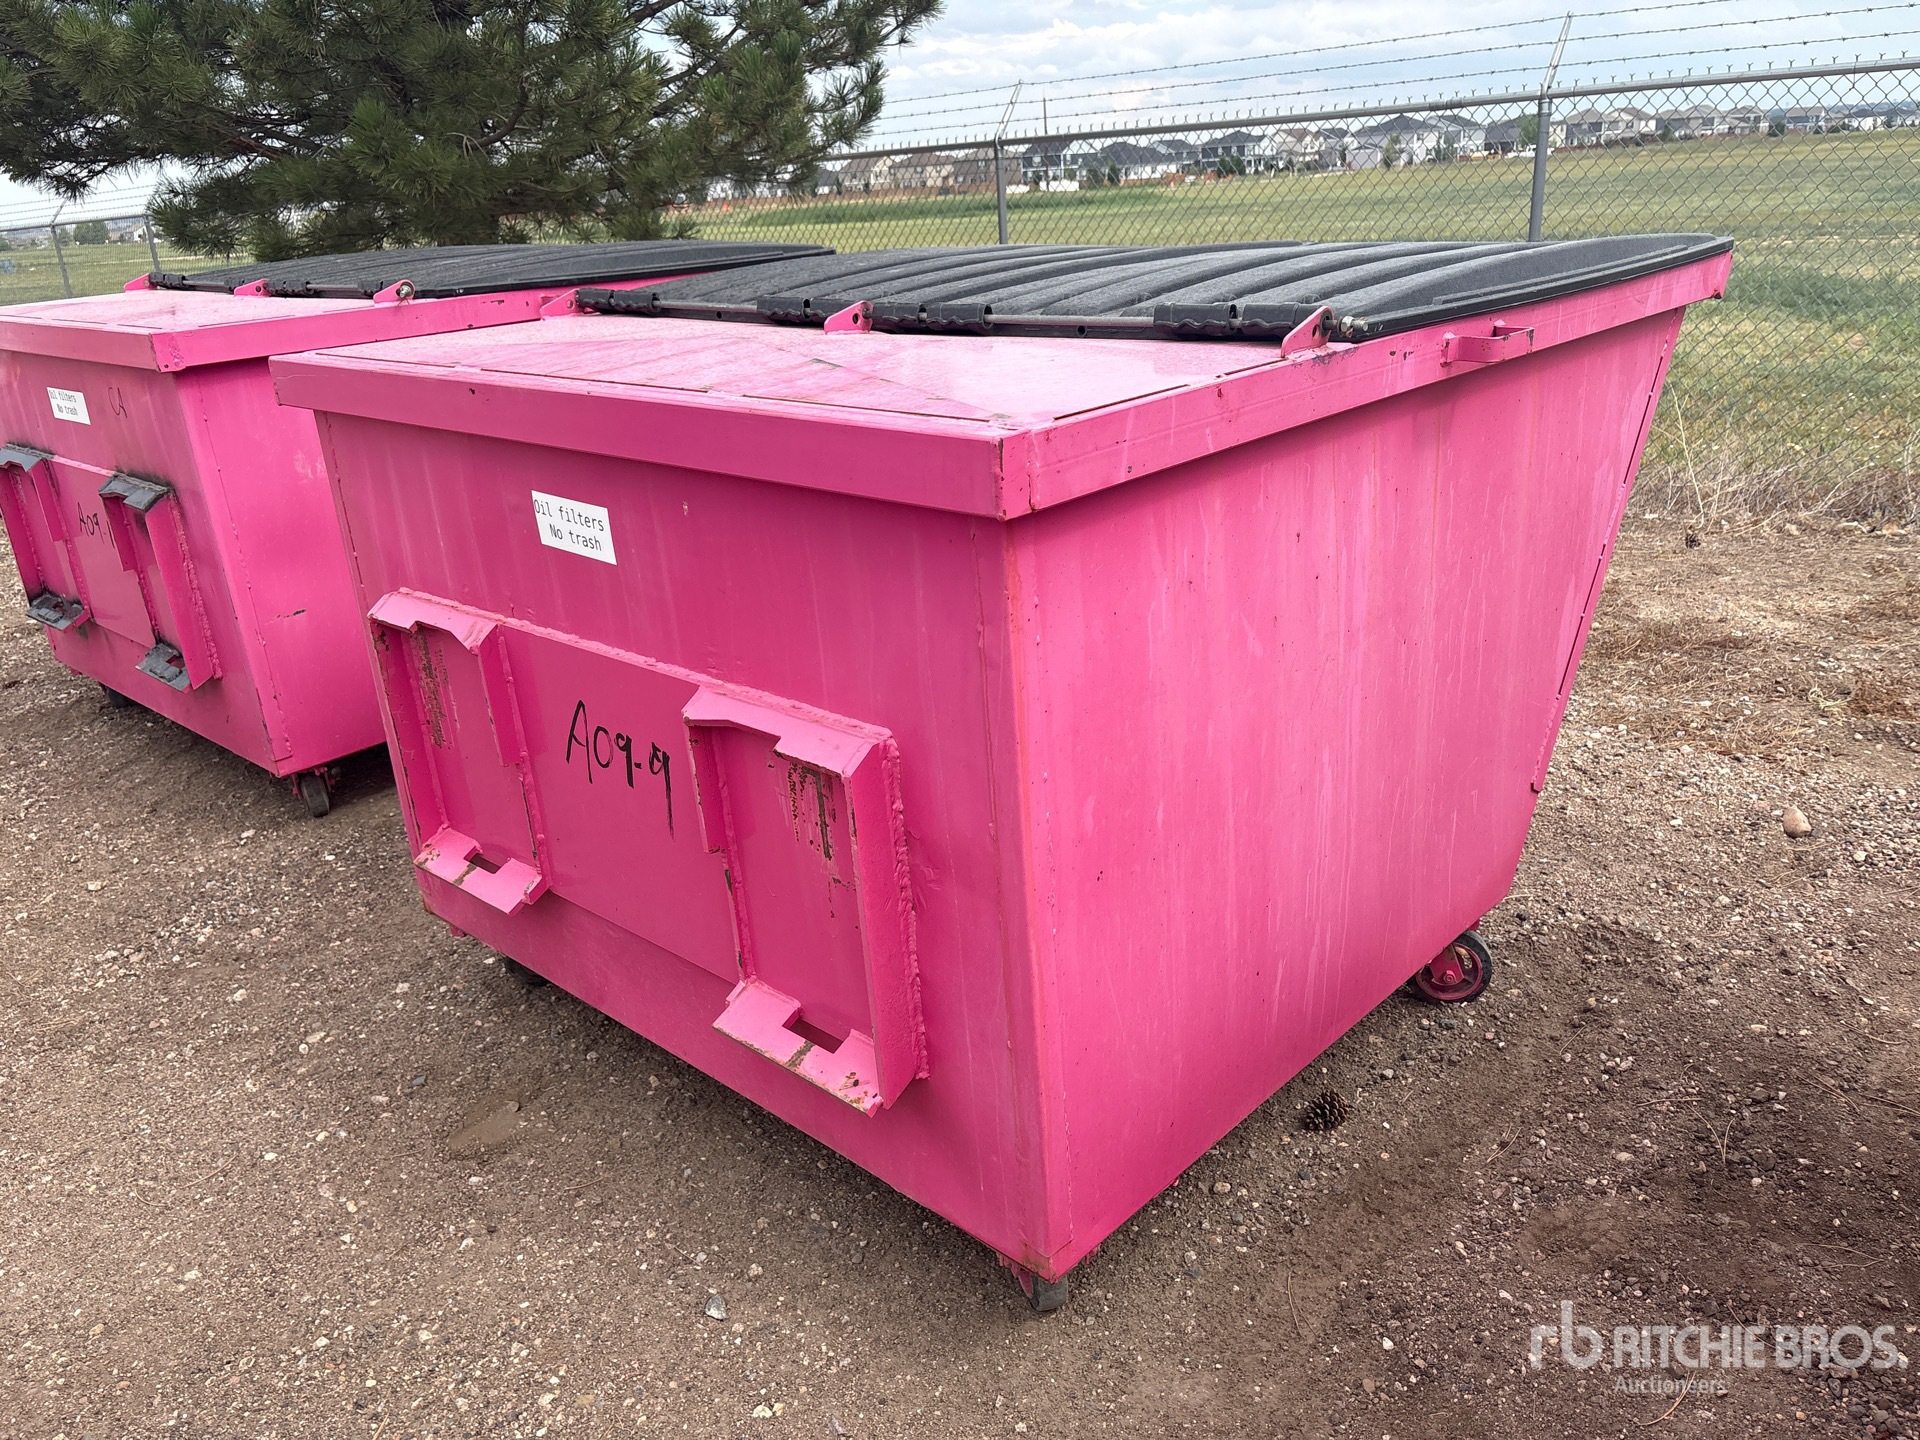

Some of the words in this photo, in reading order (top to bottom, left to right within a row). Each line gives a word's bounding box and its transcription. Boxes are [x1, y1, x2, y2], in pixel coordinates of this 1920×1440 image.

[58, 390, 77, 403] filters
[57, 403, 64, 414] No
[64, 405, 78, 417] trash
[533, 499, 552, 518] Oil
[558, 505, 605, 532] filters
[549, 523, 563, 540] No
[568, 529, 602, 552] trash
